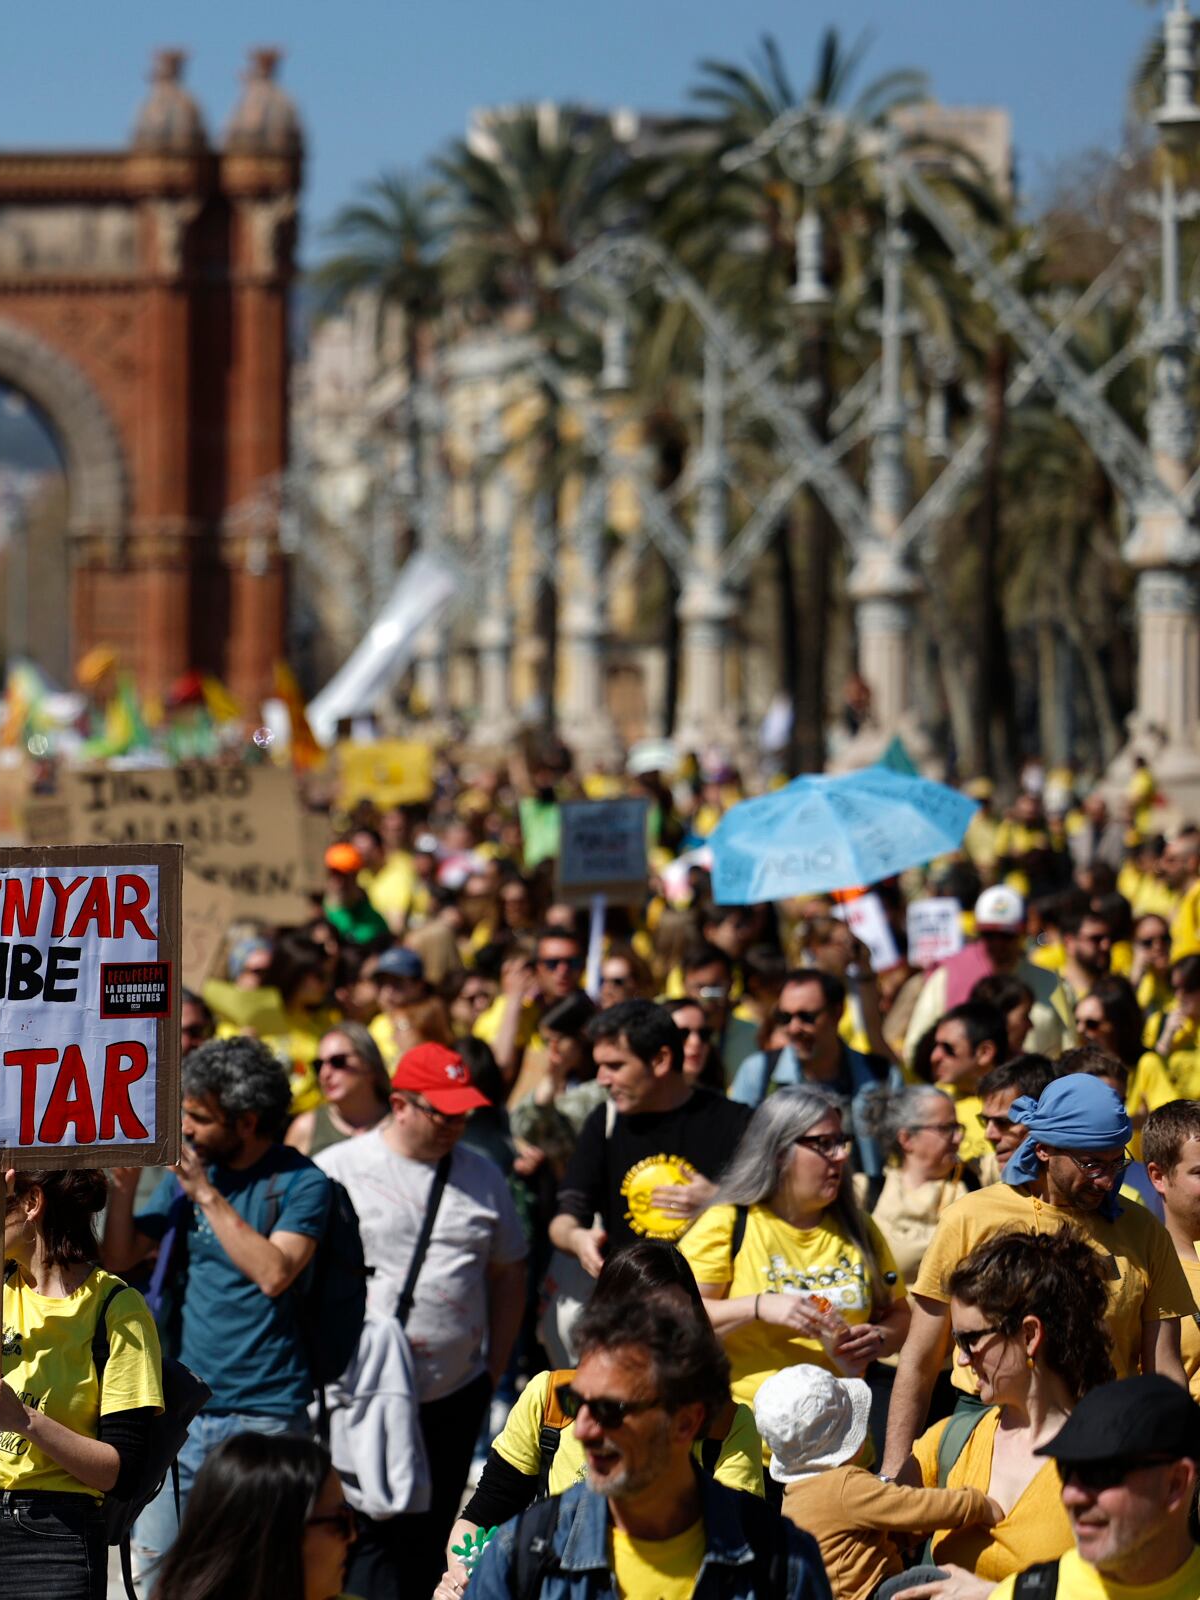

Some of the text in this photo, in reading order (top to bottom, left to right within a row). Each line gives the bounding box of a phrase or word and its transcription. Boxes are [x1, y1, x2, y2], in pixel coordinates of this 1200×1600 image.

[108, 967, 163, 984] RECUPEREM
[105, 985, 114, 993] LA
[110, 993, 160, 1003] ALS CENTRES
